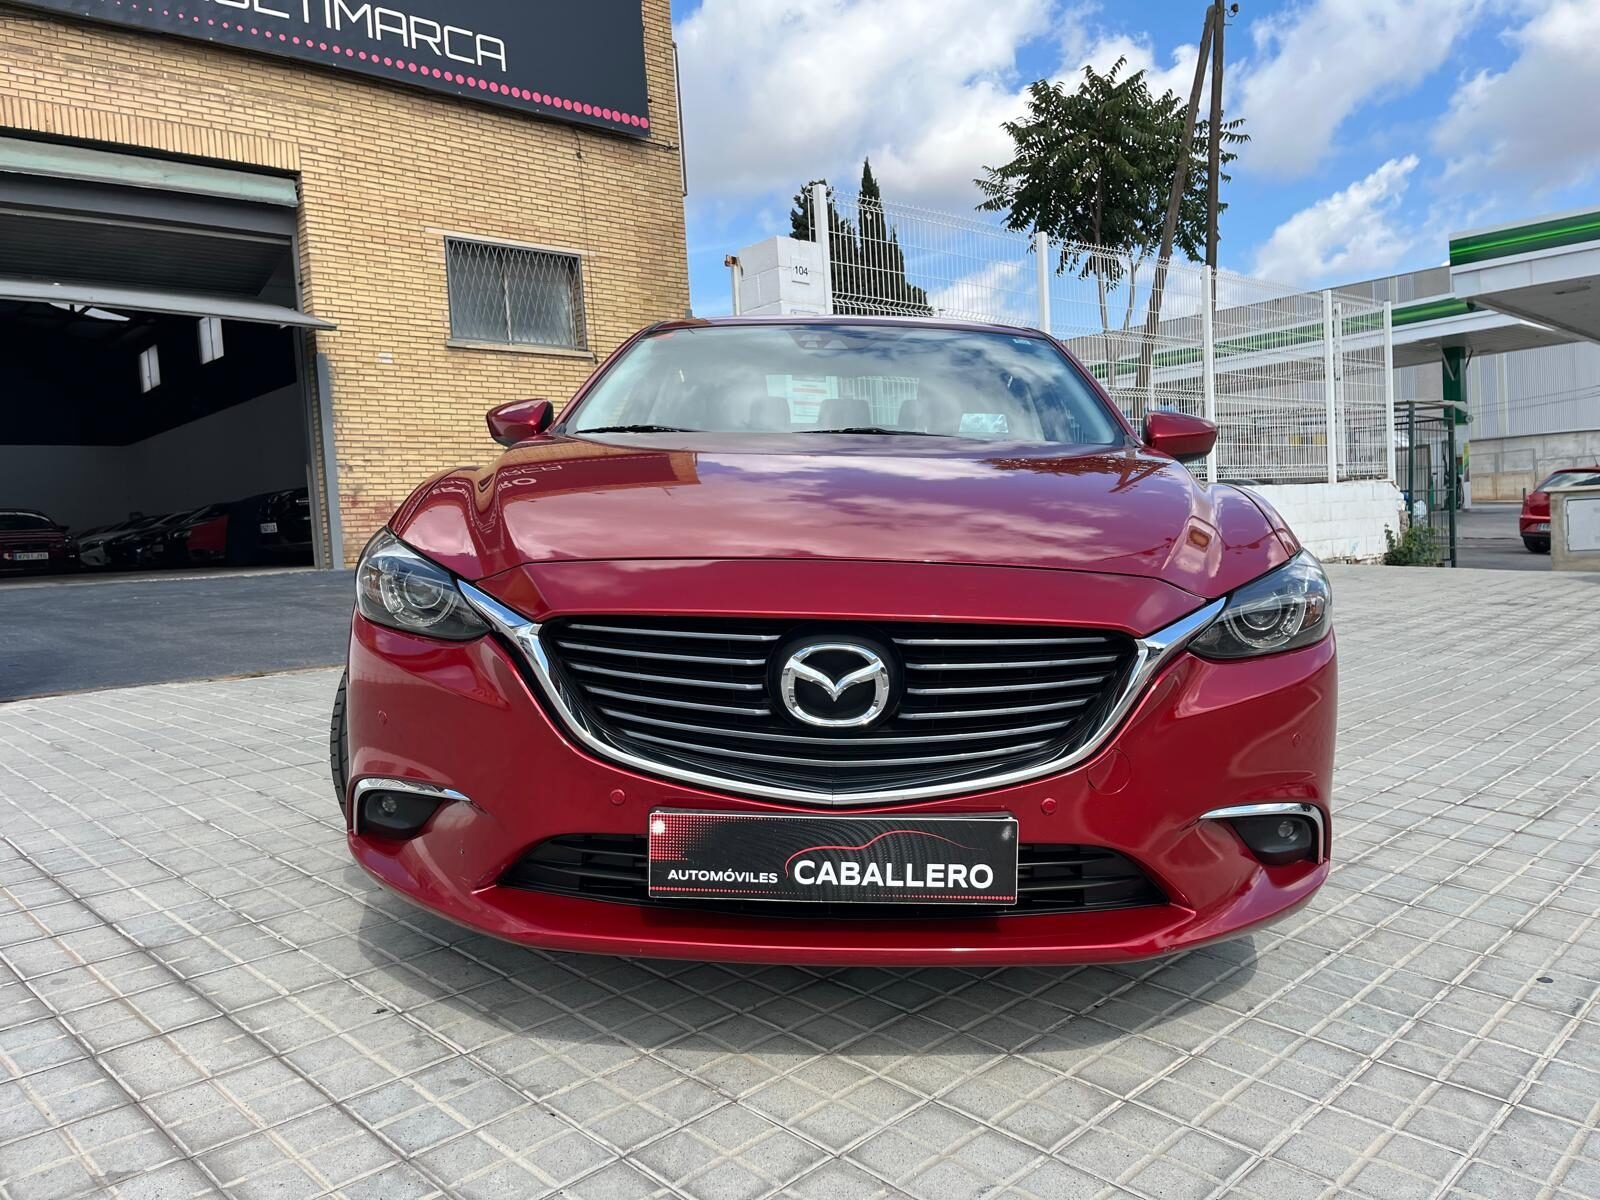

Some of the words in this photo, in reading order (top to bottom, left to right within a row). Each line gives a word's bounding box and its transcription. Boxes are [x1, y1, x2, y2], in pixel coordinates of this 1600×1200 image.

[794, 265, 809, 277] 104
[667, 868, 778, 884] AUTOMÓVILES
[793, 859, 994, 889] CABALLERO
